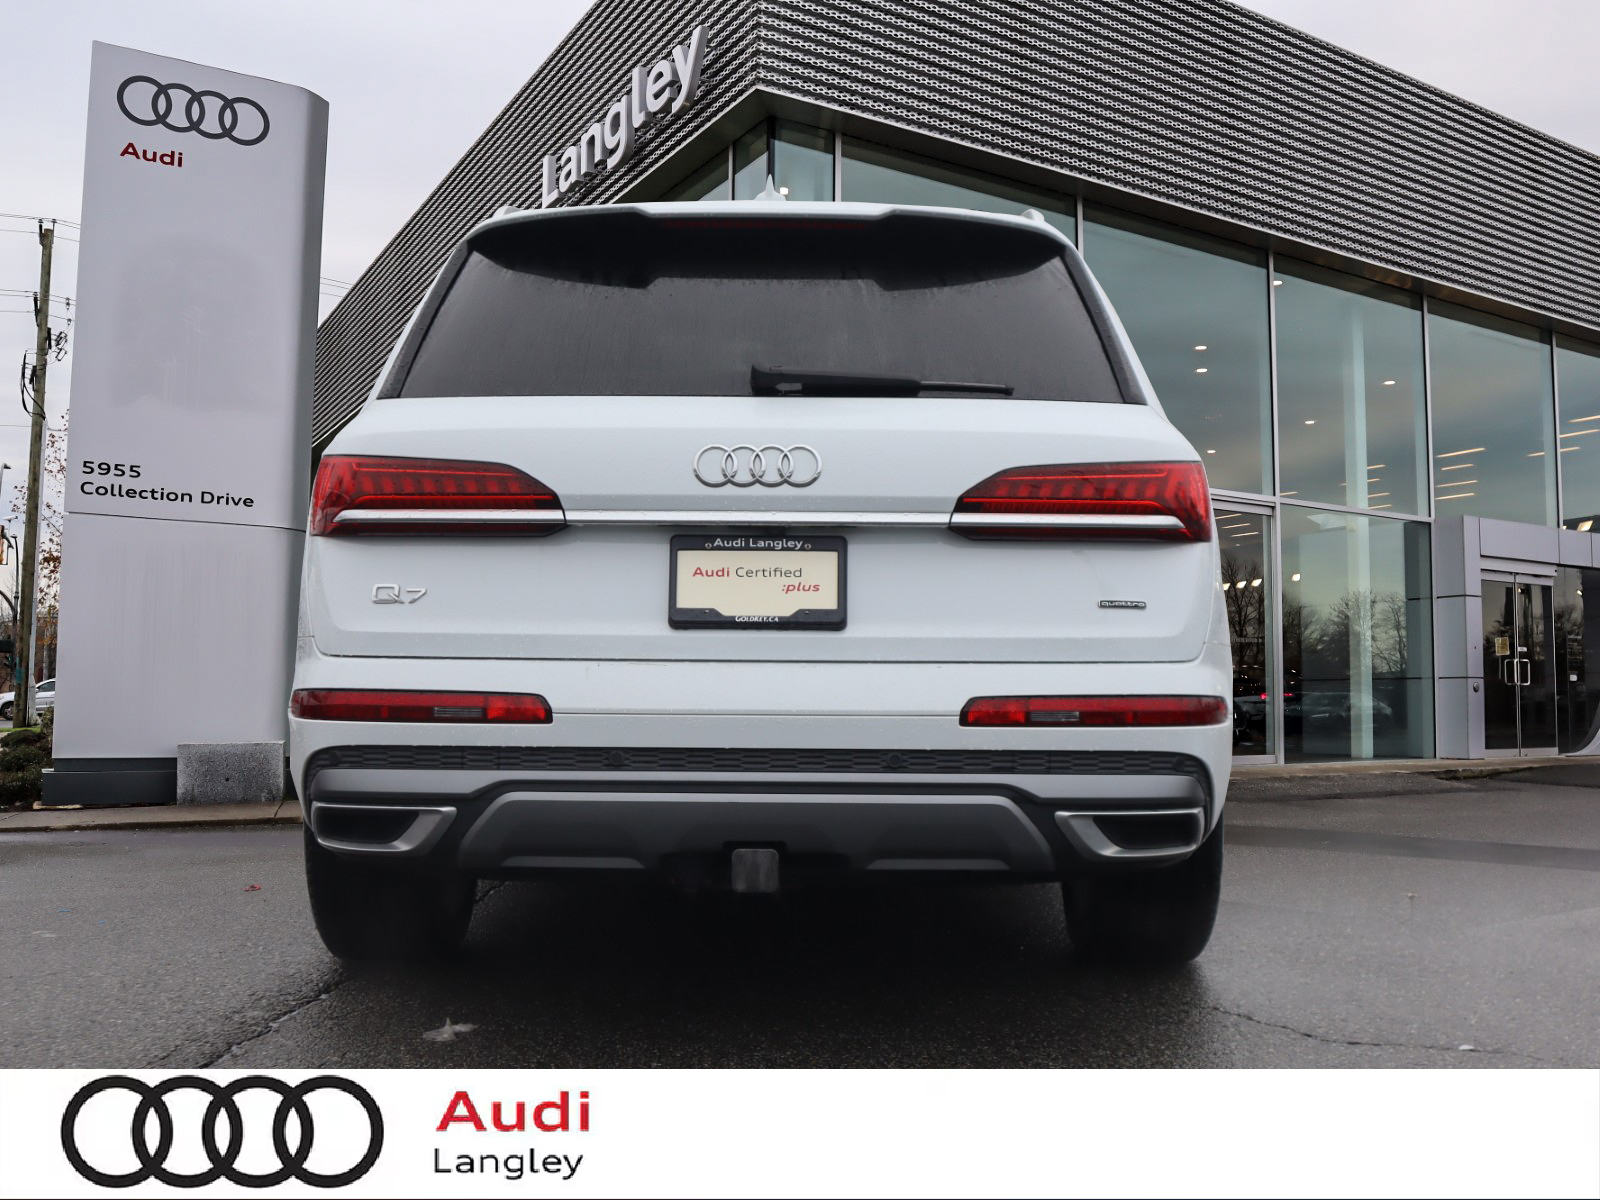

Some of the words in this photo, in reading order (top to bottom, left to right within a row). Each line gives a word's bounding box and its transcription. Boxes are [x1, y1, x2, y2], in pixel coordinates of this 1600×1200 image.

[541, 25, 710, 209] Langley
[120, 142, 183, 168] Audi
[82, 460, 141, 478] 5955
[80, 481, 193, 503] Collection
[200, 491, 255, 507] Drive
[713, 538, 745, 548] Audi
[749, 538, 804, 550] Langley
[692, 566, 730, 578] Audi
[735, 566, 803, 578] Certified
[371, 583, 427, 604] Q7
[1100, 600, 1146, 608] quattro
